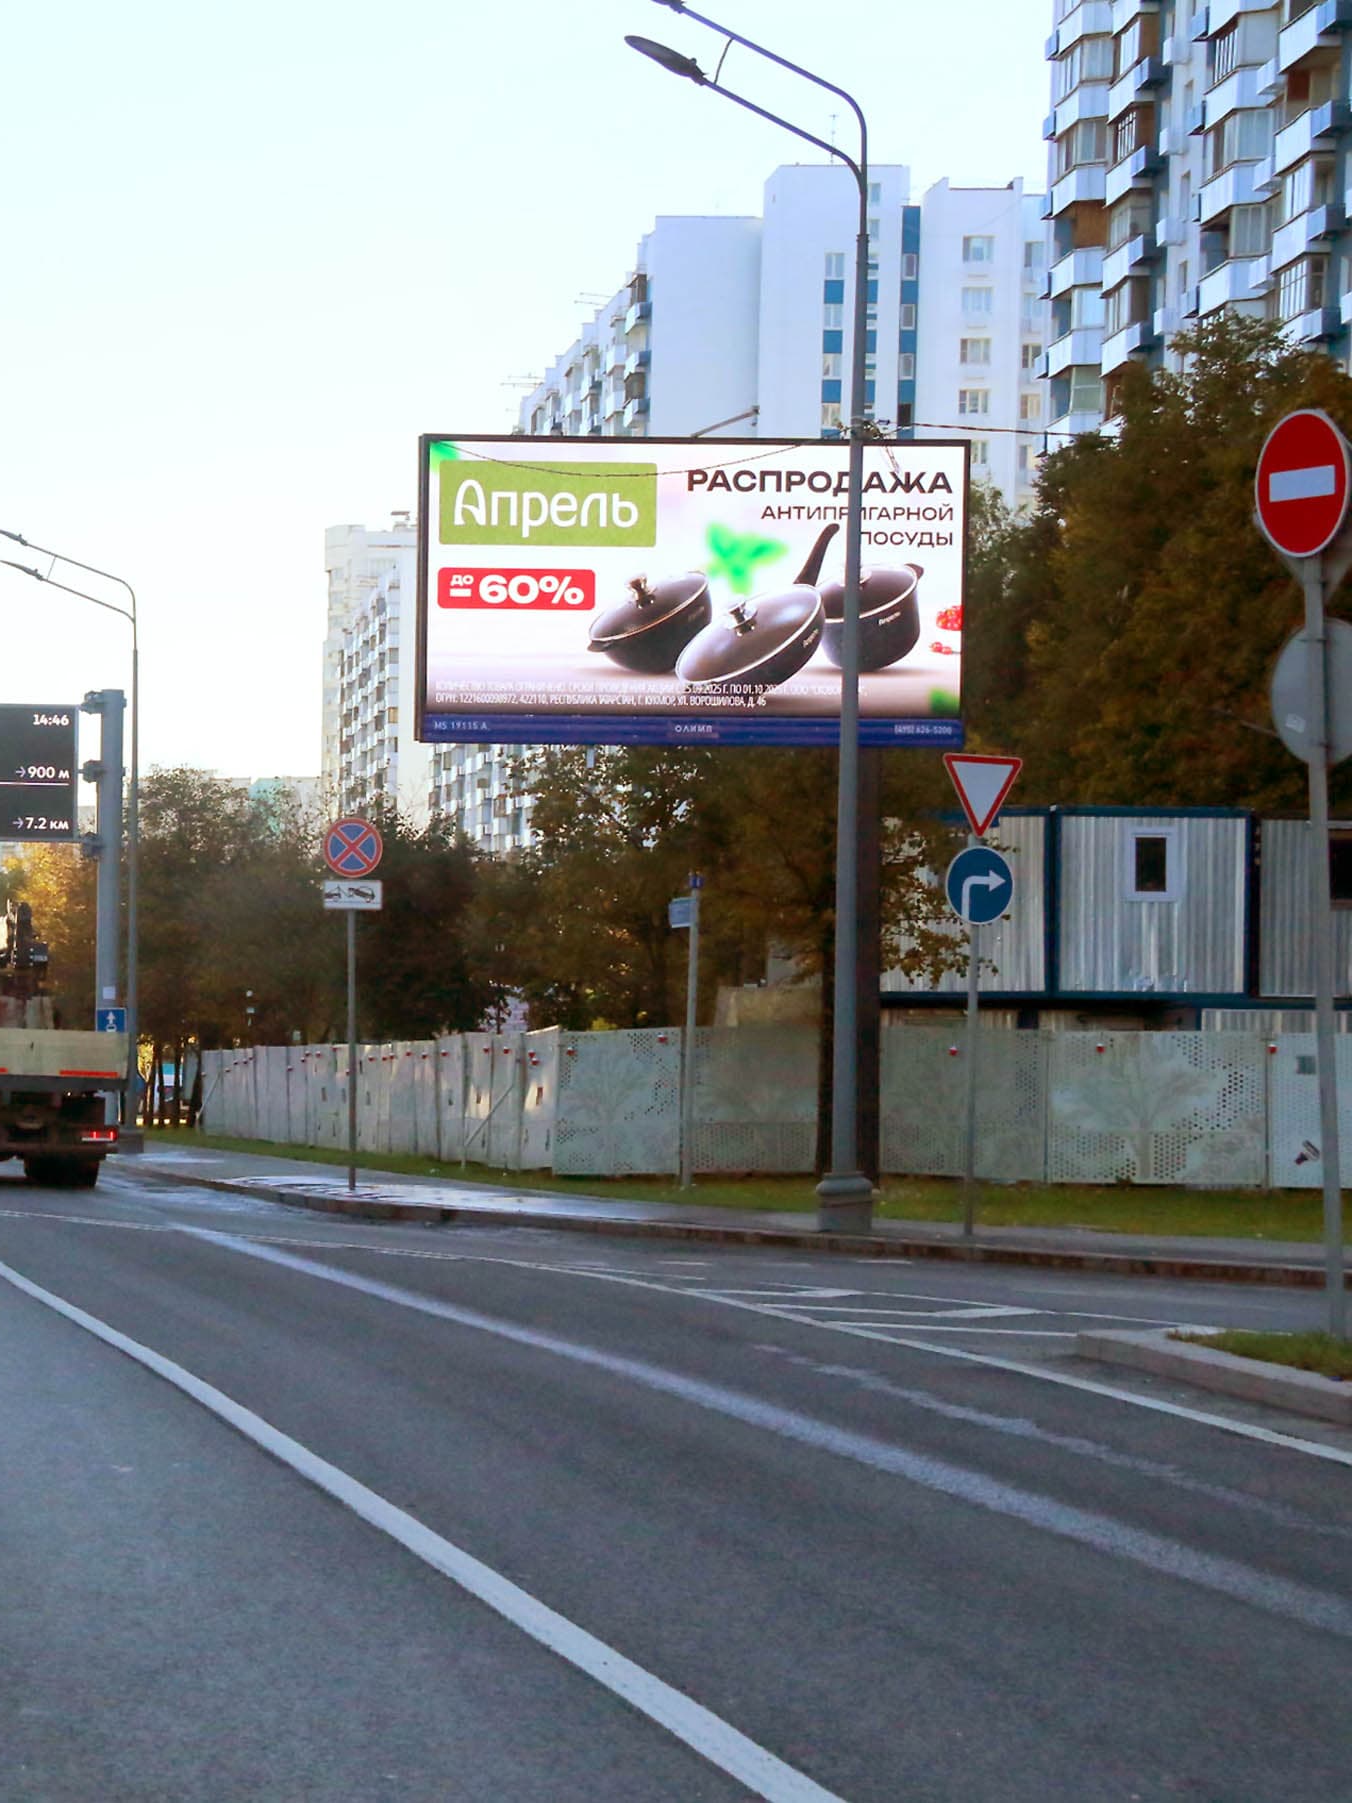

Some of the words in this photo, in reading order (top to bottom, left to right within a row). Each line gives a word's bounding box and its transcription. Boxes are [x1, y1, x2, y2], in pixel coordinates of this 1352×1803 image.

[687, 470, 952, 497] РАСПРОДАЖА
[453, 479, 639, 538] Апрель
[860, 531, 953, 548] ПОСУДЫ
[33, 714, 69, 726] 14:46
[674, 724, 714, 733] ОЛИМП
[28, 766, 56, 778] 900
[58, 769, 69, 779] м
[25, 817, 47, 829] 7.2
[49, 820, 69, 830] км
